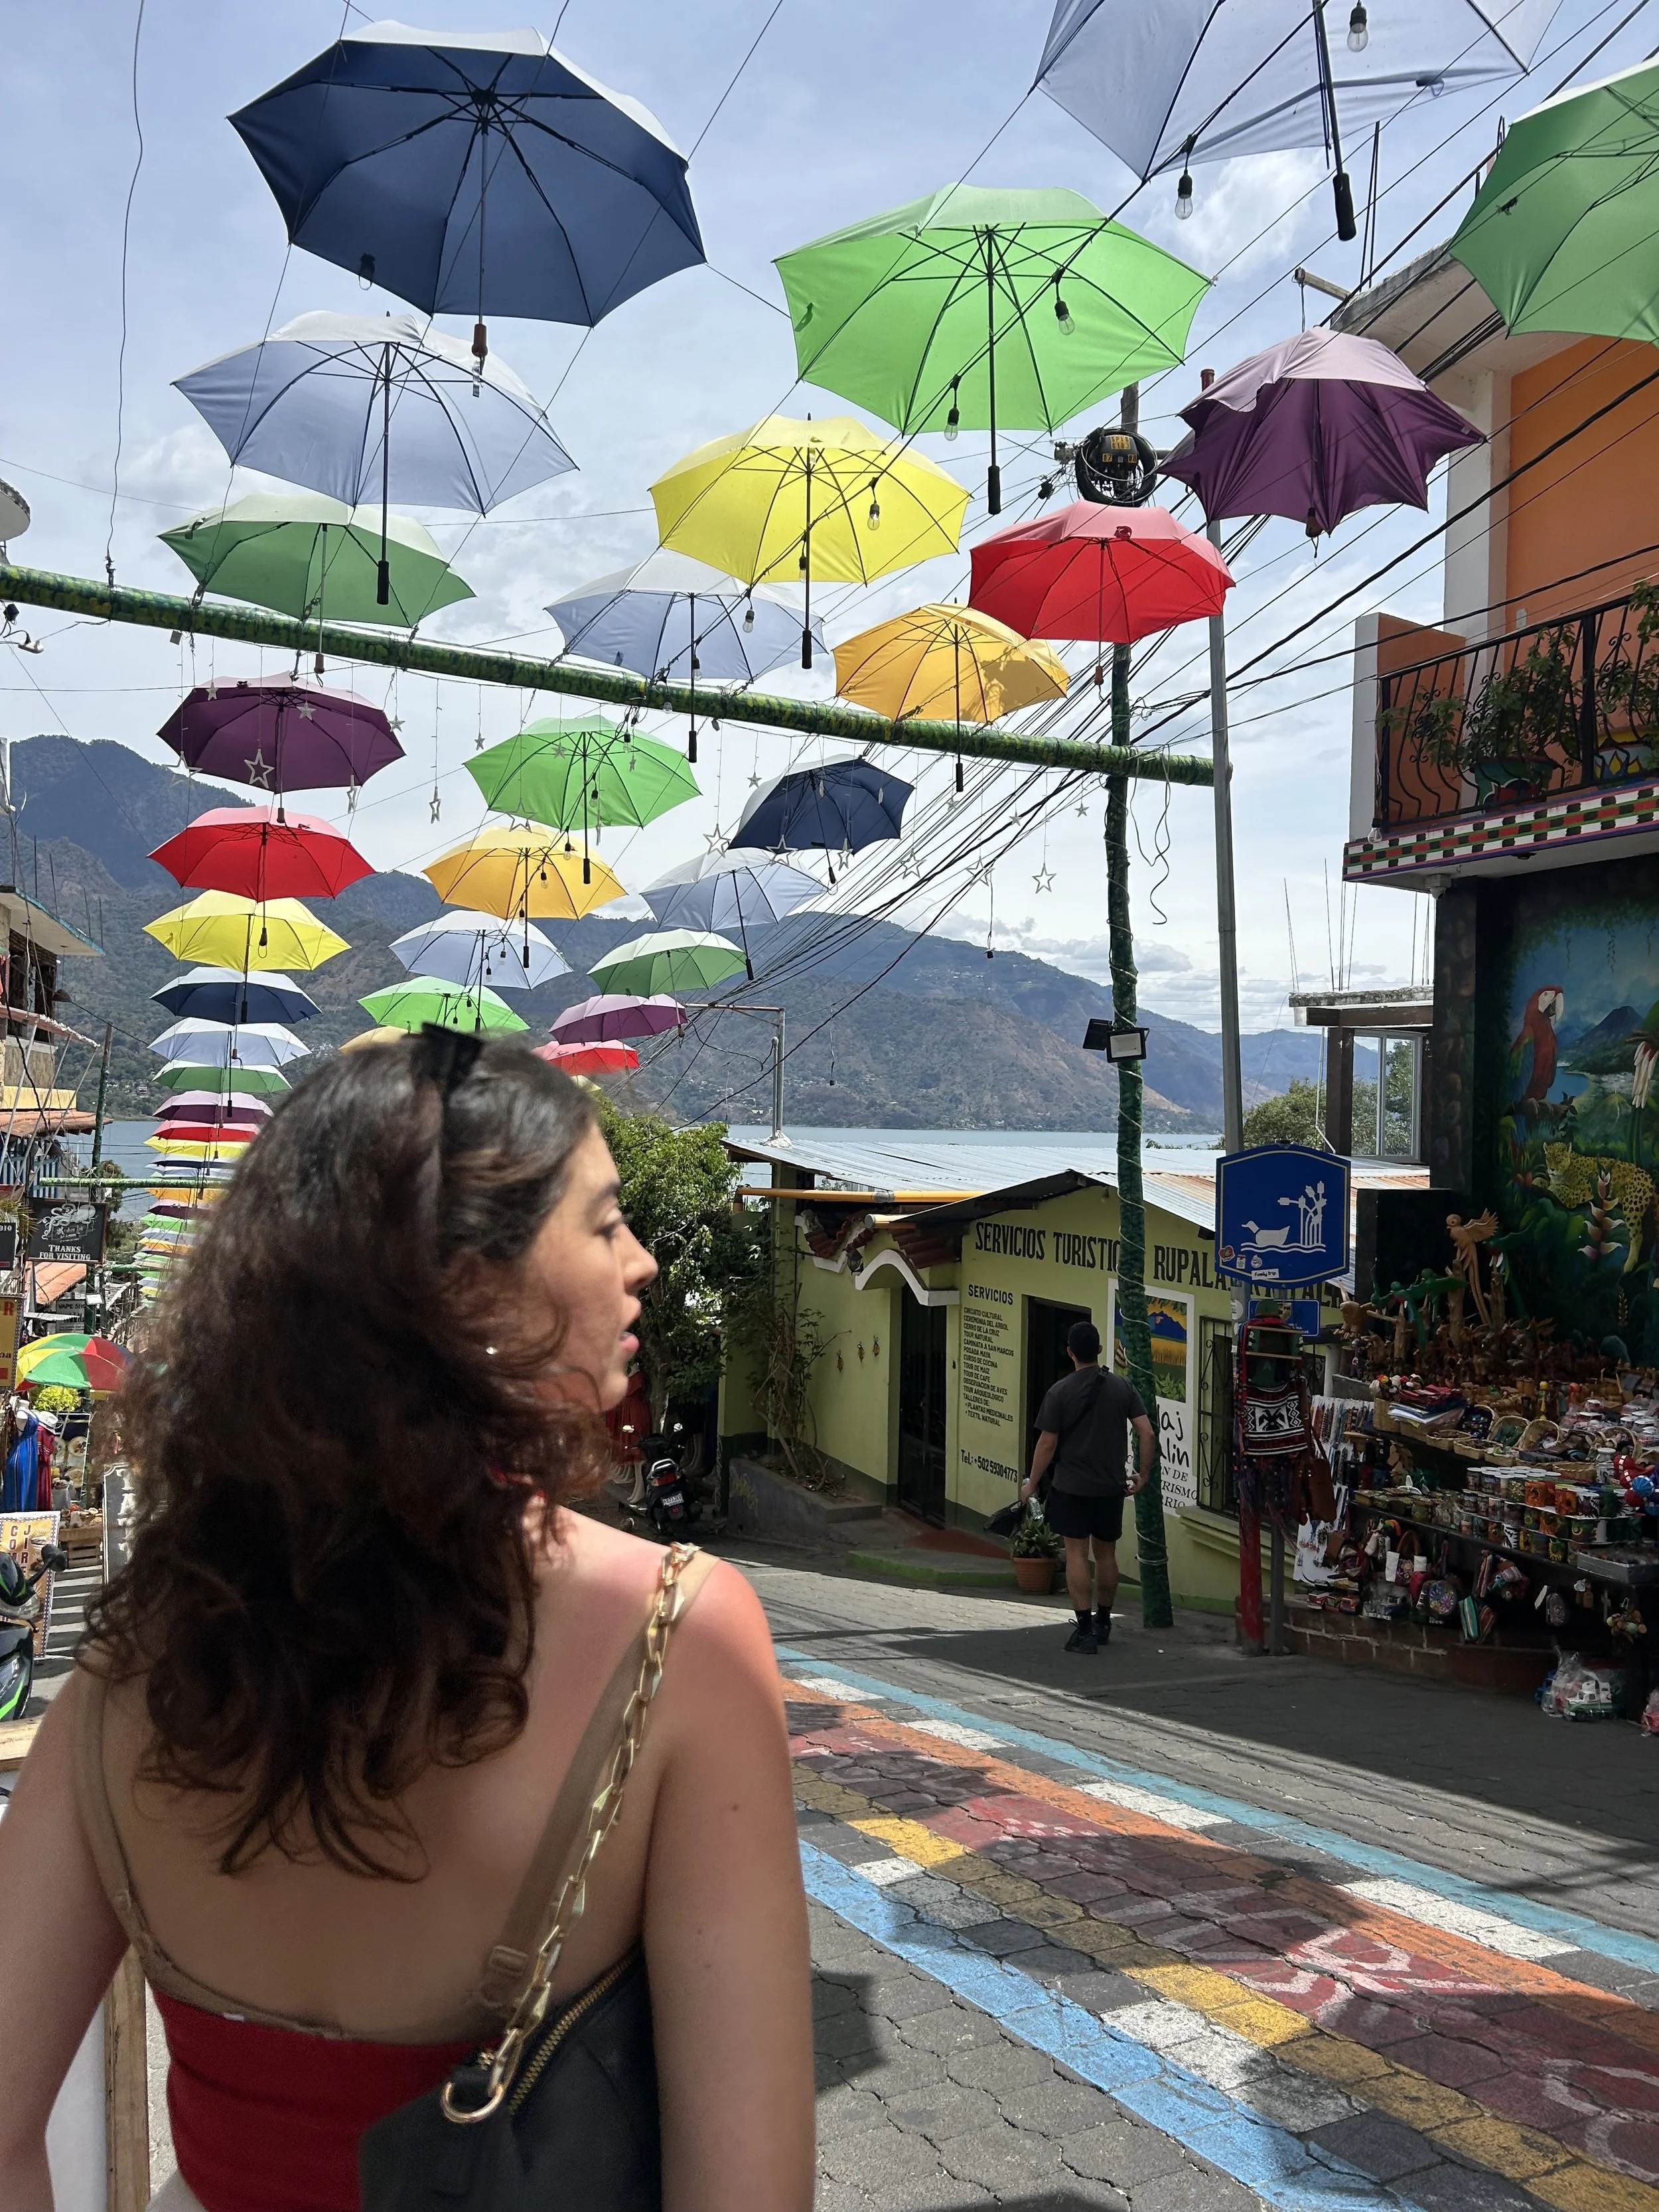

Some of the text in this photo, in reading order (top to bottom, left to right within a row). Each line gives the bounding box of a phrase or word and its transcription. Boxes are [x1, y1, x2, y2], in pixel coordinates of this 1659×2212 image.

[48, 1244, 82, 1253] THANKS
[975, 1221, 1231, 1291] SERVICIOS TURISTIC RUPALA
[968, 1284, 1013, 1305] SERVICIOS
[964, 1315, 986, 1325] CEREMONIA
[982, 1311, 1003, 1321] CULTURAL
[975, 1333, 993, 1343] NATURAL
[964, 1338, 983, 1349] CAMINATA
[997, 1346, 1014, 1357] MARCOS
[964, 1346, 979, 1355] POSADA
[964, 1362, 974, 1370] TOUR
[983, 1359, 998, 1368] COCINA
[964, 1369, 974, 1378] TOUR
[964, 1385, 974, 1394] TOUR
[997, 1386, 1008, 1396] AVES
[964, 1393, 983, 1404] TALLERES
[982, 1414, 1001, 1426] NATURAL
[1173, 1469, 1188, 1482] DE
[1161, 1480, 1197, 1501] RISMO
[1163, 1496, 1185, 1509] RIO
